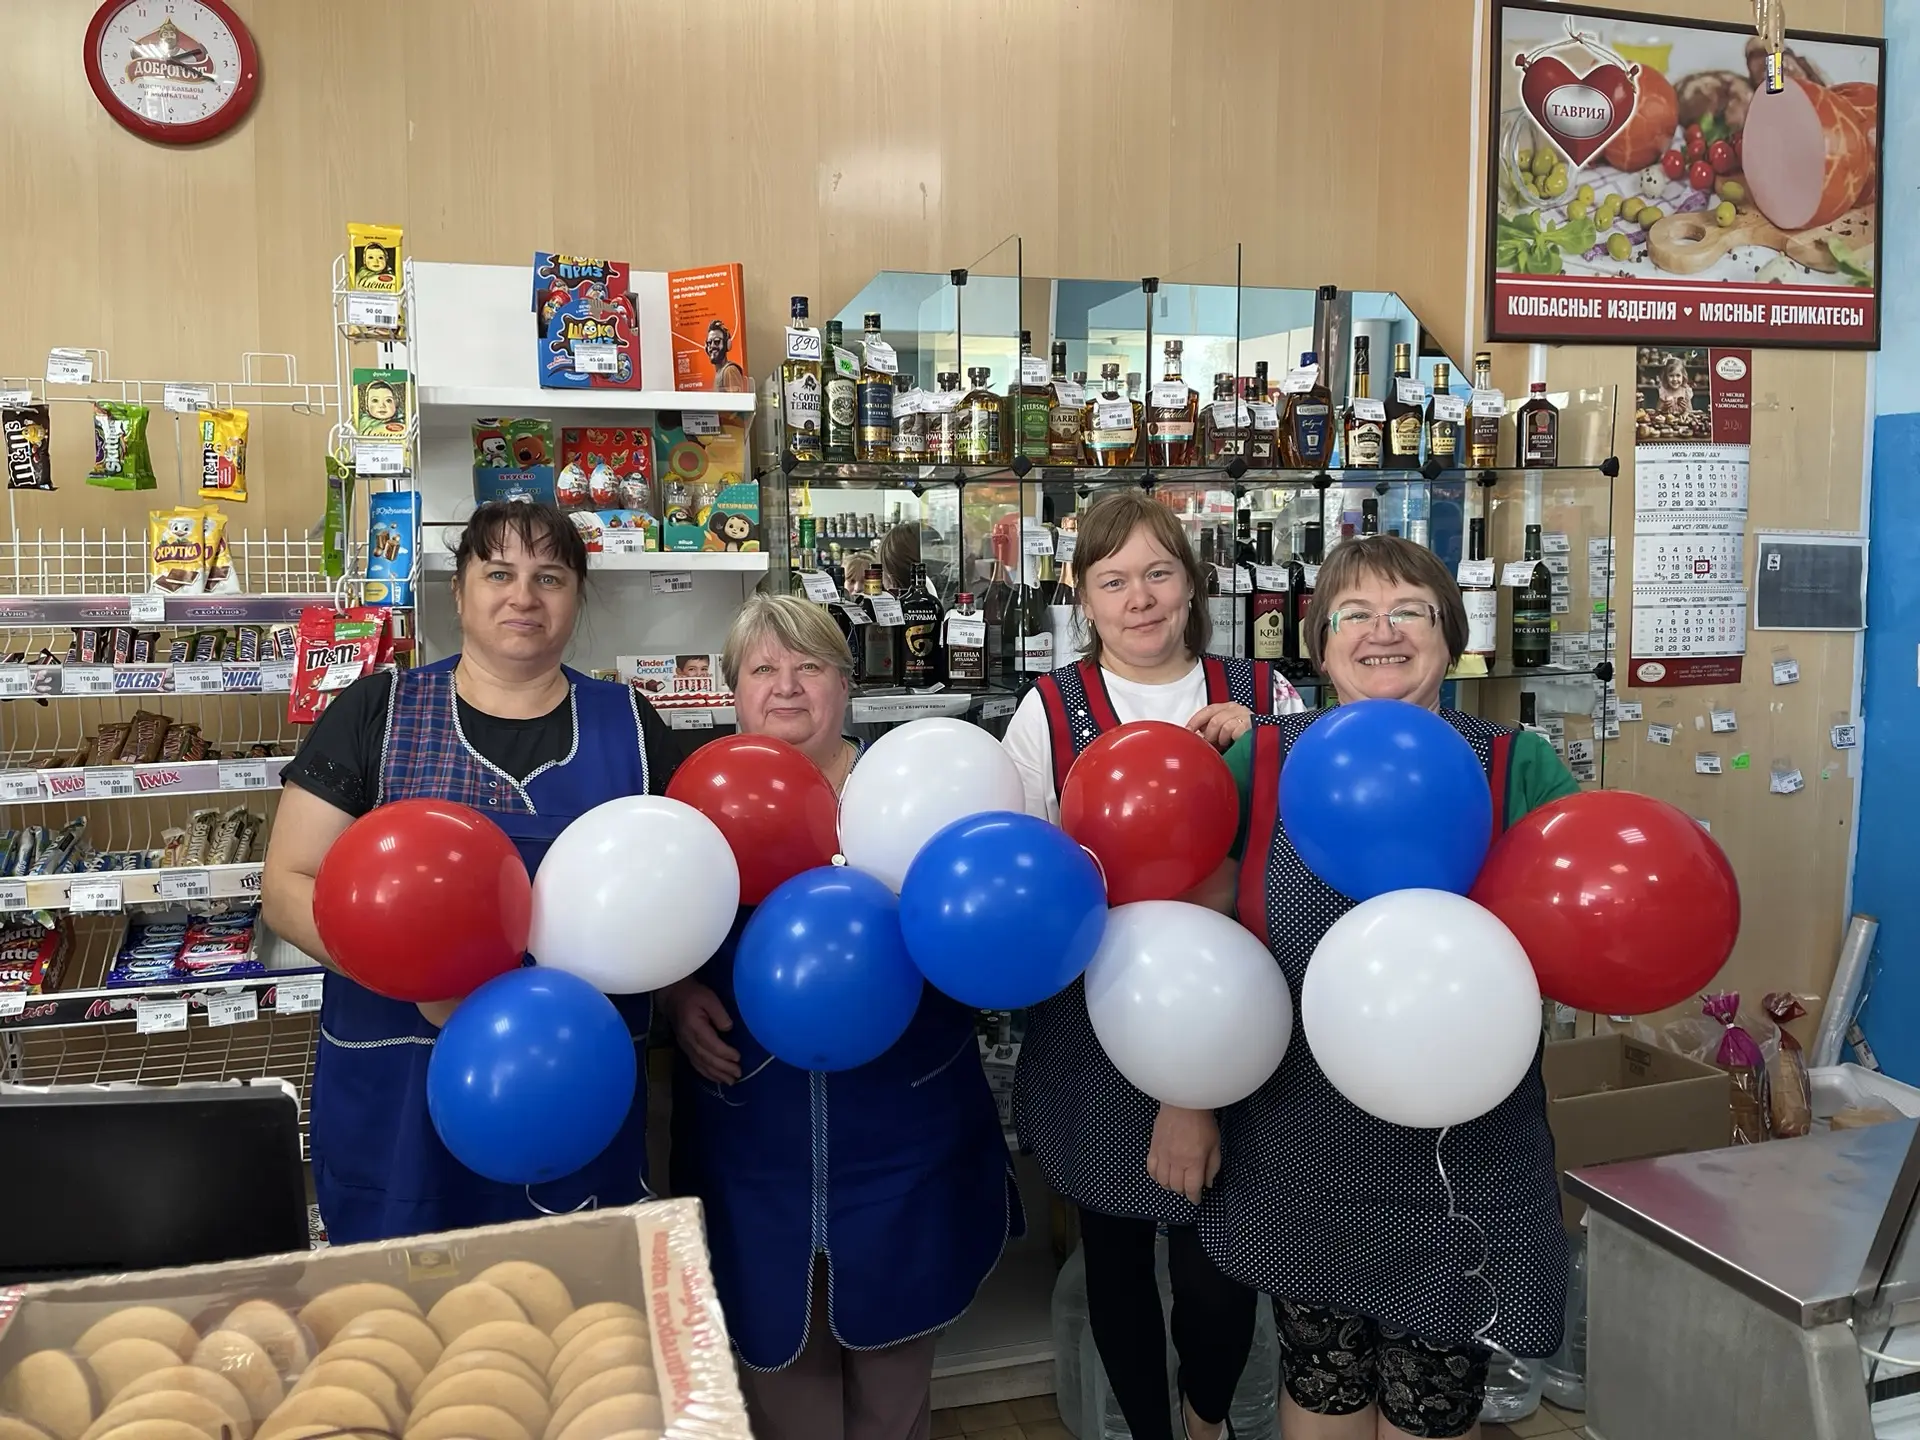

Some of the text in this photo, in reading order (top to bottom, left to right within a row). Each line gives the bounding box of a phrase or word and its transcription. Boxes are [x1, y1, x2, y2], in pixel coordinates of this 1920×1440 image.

[1552, 104, 1606, 120] ТАВРИЯ
[560, 264, 604, 278] ПРИЗ
[1508, 295, 1864, 326] КОЛБАСНЫЕ ИЗДЕЛИЯ МЯСНЫЕ ДЕЛИКАТЕСЫ
[568, 320, 615, 339] ШОКО
[792, 336, 819, 351] 890
[156, 545, 198, 559] ХРУТКА
[637, 659, 664, 667] Kinder
[135, 770, 181, 790] Twix
